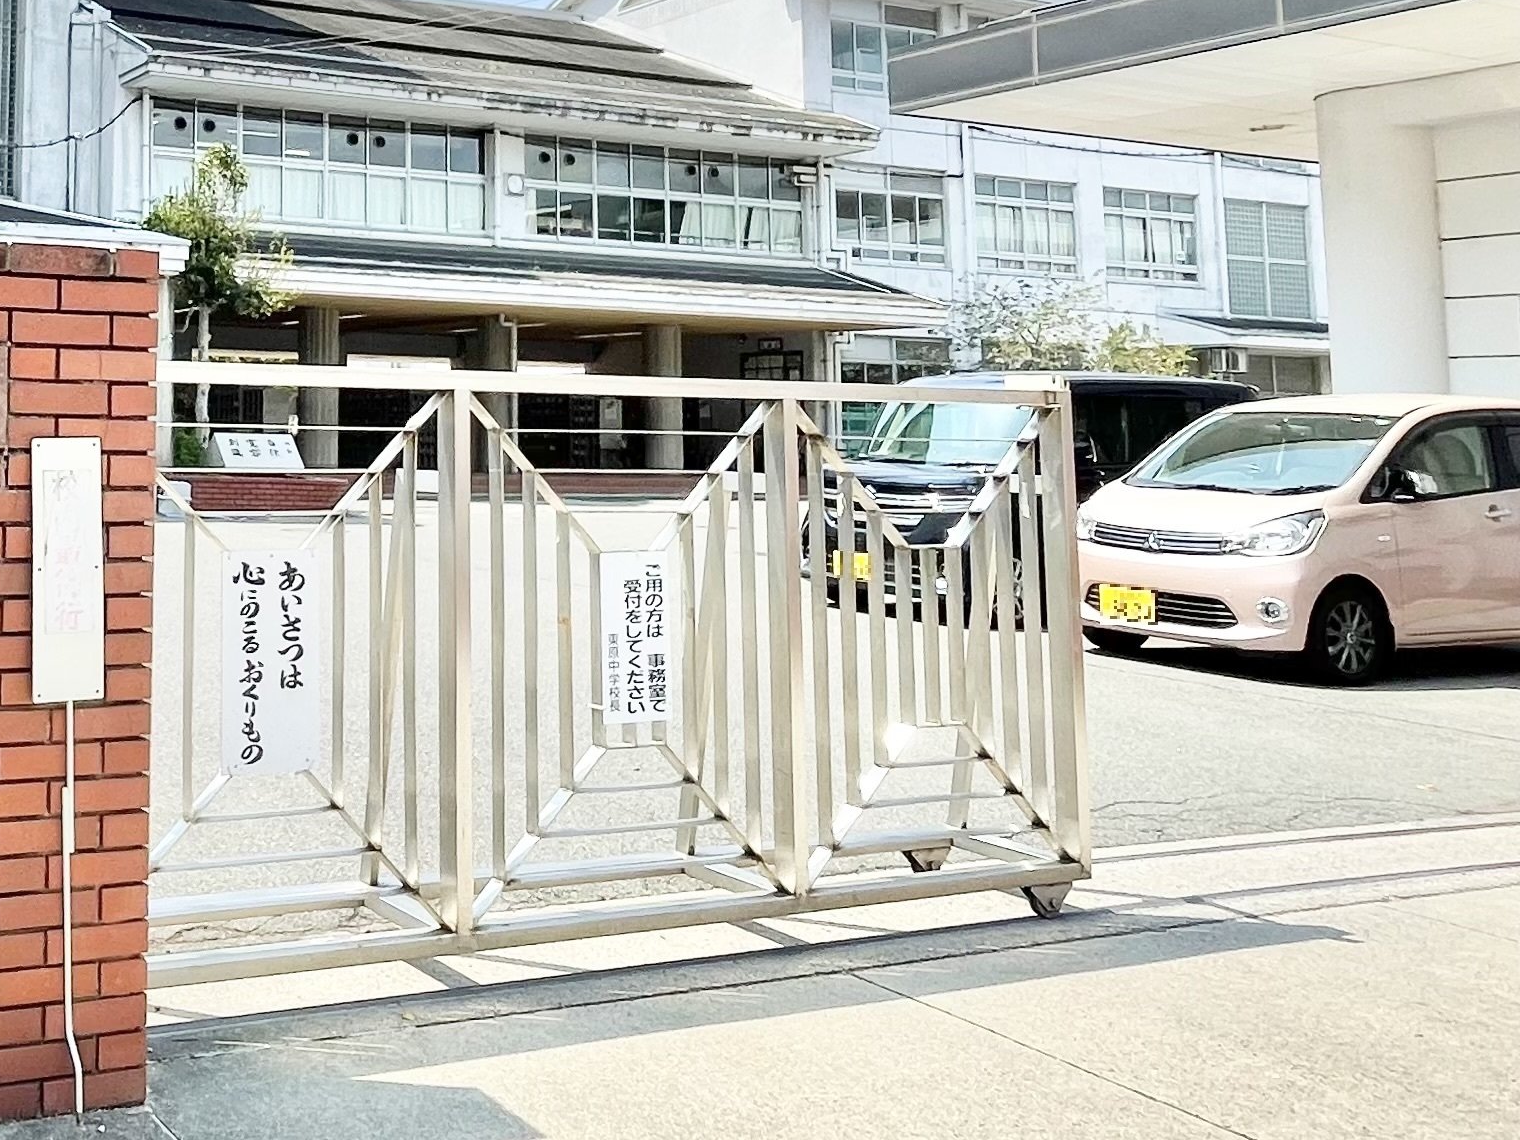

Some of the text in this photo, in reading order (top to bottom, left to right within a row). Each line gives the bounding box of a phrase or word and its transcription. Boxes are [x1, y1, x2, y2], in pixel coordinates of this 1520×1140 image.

[277, 561, 306, 689] あいさつは
[623, 579, 646, 714] 受付をしてください
